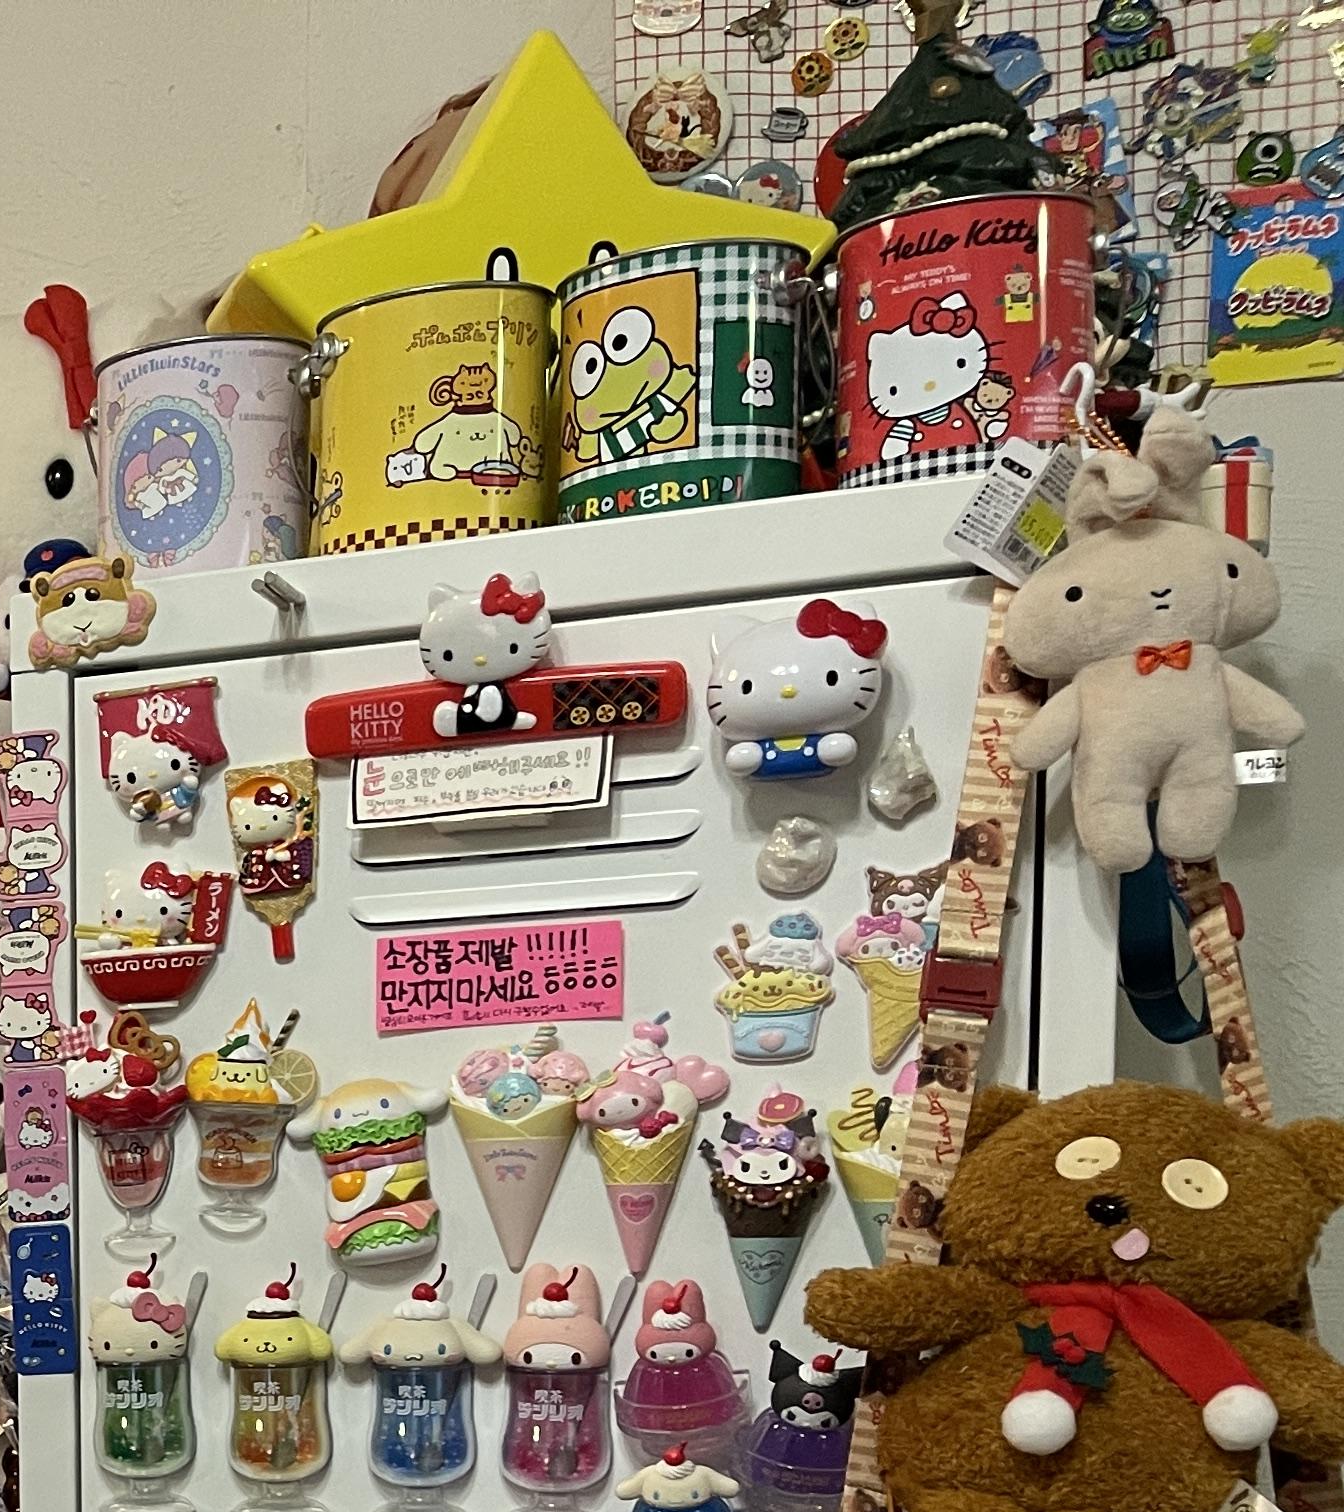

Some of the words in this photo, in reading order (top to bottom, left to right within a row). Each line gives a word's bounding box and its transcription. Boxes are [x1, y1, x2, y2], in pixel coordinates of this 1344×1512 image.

[879, 229, 960, 267] Hello
[963, 217, 1040, 254] Kitty
[351, 701, 405, 721] HELLO
[351, 719, 404, 740] KITTY
[203, 880, 223, 940] ラーメン
[18, 1322, 43, 1335] HELLO
[44, 1322, 68, 1333] KITTY
[116, 1377, 143, 1393] 喫茶
[253, 1381, 280, 1396] 喫茶
[398, 1385, 427, 1399] 喫茶
[104, 1391, 163, 1409] サンリオ
[239, 1394, 301, 1412] サンリオ
[535, 1389, 563, 1405] 喫茶
[383, 1397, 447, 1417] サンリオ
[517, 1401, 585, 1424] サンリオ
